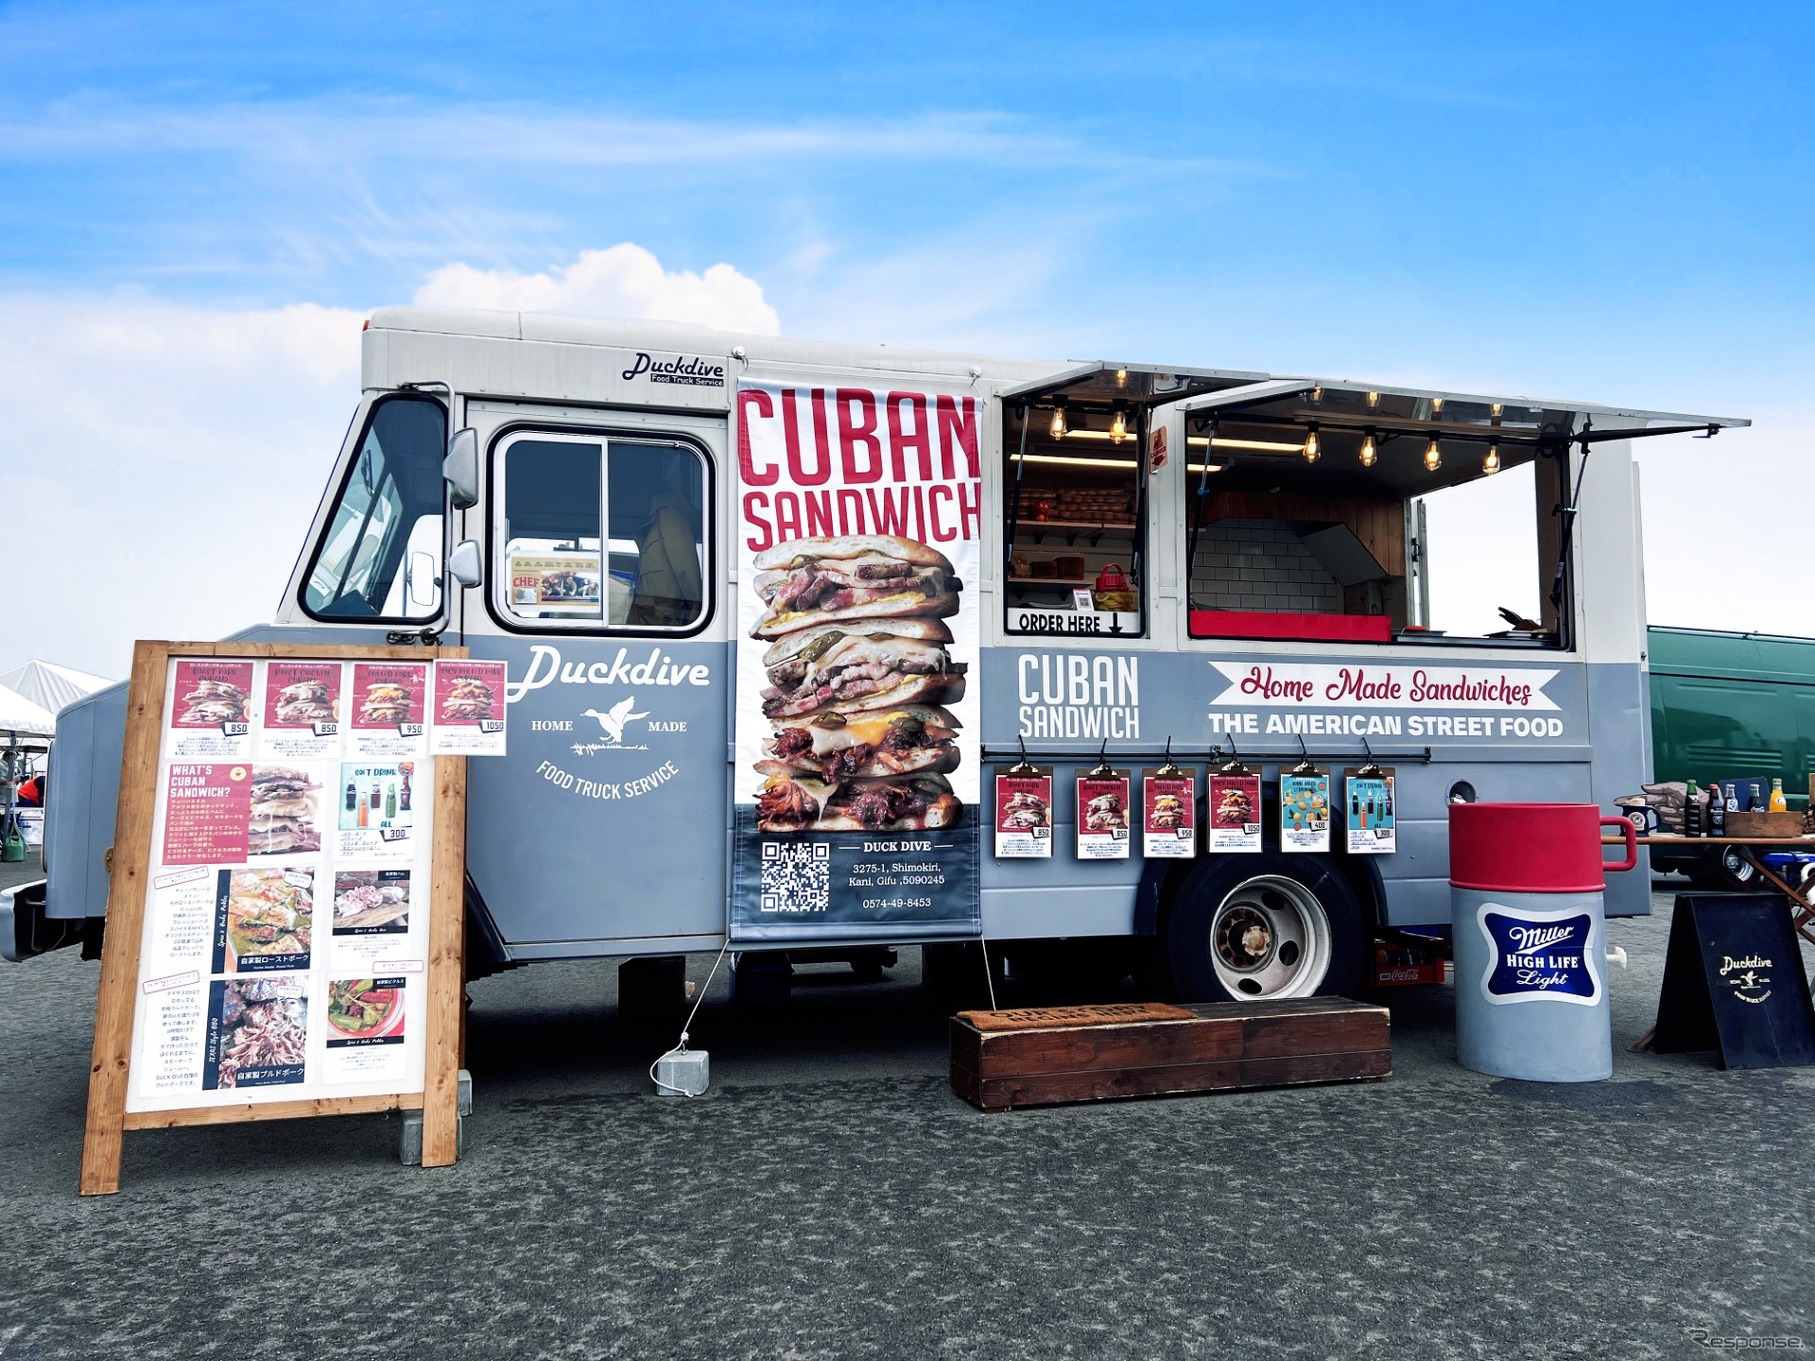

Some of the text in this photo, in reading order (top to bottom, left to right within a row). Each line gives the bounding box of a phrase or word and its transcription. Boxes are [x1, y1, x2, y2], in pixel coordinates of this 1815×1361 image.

[622, 352, 724, 381] Duckdive
[652, 374, 724, 387] Food Truck Service
[738, 388, 980, 486] CUBAN
[743, 482, 981, 552] SANDWICH
[514, 576, 539, 588] CHEF
[1019, 613, 1100, 632] ORDER HERE
[507, 645, 710, 703] Duckdive
[1018, 654, 1138, 706] CUBAN
[1240, 666, 1532, 706] Home Made Sandwiches
[486, 722, 504, 730] 1050
[531, 720, 687, 732] HOME MADE
[1019, 706, 1140, 738] SANDWICH
[1208, 713, 1564, 737] THE AMERICAN STREET FOOD
[231, 724, 248, 733] 850
[321, 724, 336, 733] 850
[406, 724, 422, 734] 950
[172, 766, 212, 776] WHAT'S
[172, 776, 206, 786] CUBAN
[536, 760, 680, 800] FOOD TRUCK SERVICE
[170, 787, 231, 798] SANDWICH?
[390, 829, 405, 837] 300
[1038, 829, 1050, 837] 850
[1181, 829, 1193, 837] 950
[1248, 824, 1260, 832] 1050
[864, 841, 931, 852] DUCK DIVE
[853, 862, 941, 874] 3275-1, Shimokiri,
[849, 877, 874, 886] Kani,
[877, 877, 896, 886] Gifu
[862, 898, 931, 909] 0574-49-8453
[1509, 925, 1574, 953] Miller
[240, 954, 309, 964] 自家製ローストポーク
[1506, 954, 1579, 968] HIGH LIFE
[1720, 955, 1773, 976] Duckdive
[1516, 969, 1568, 990] Light
